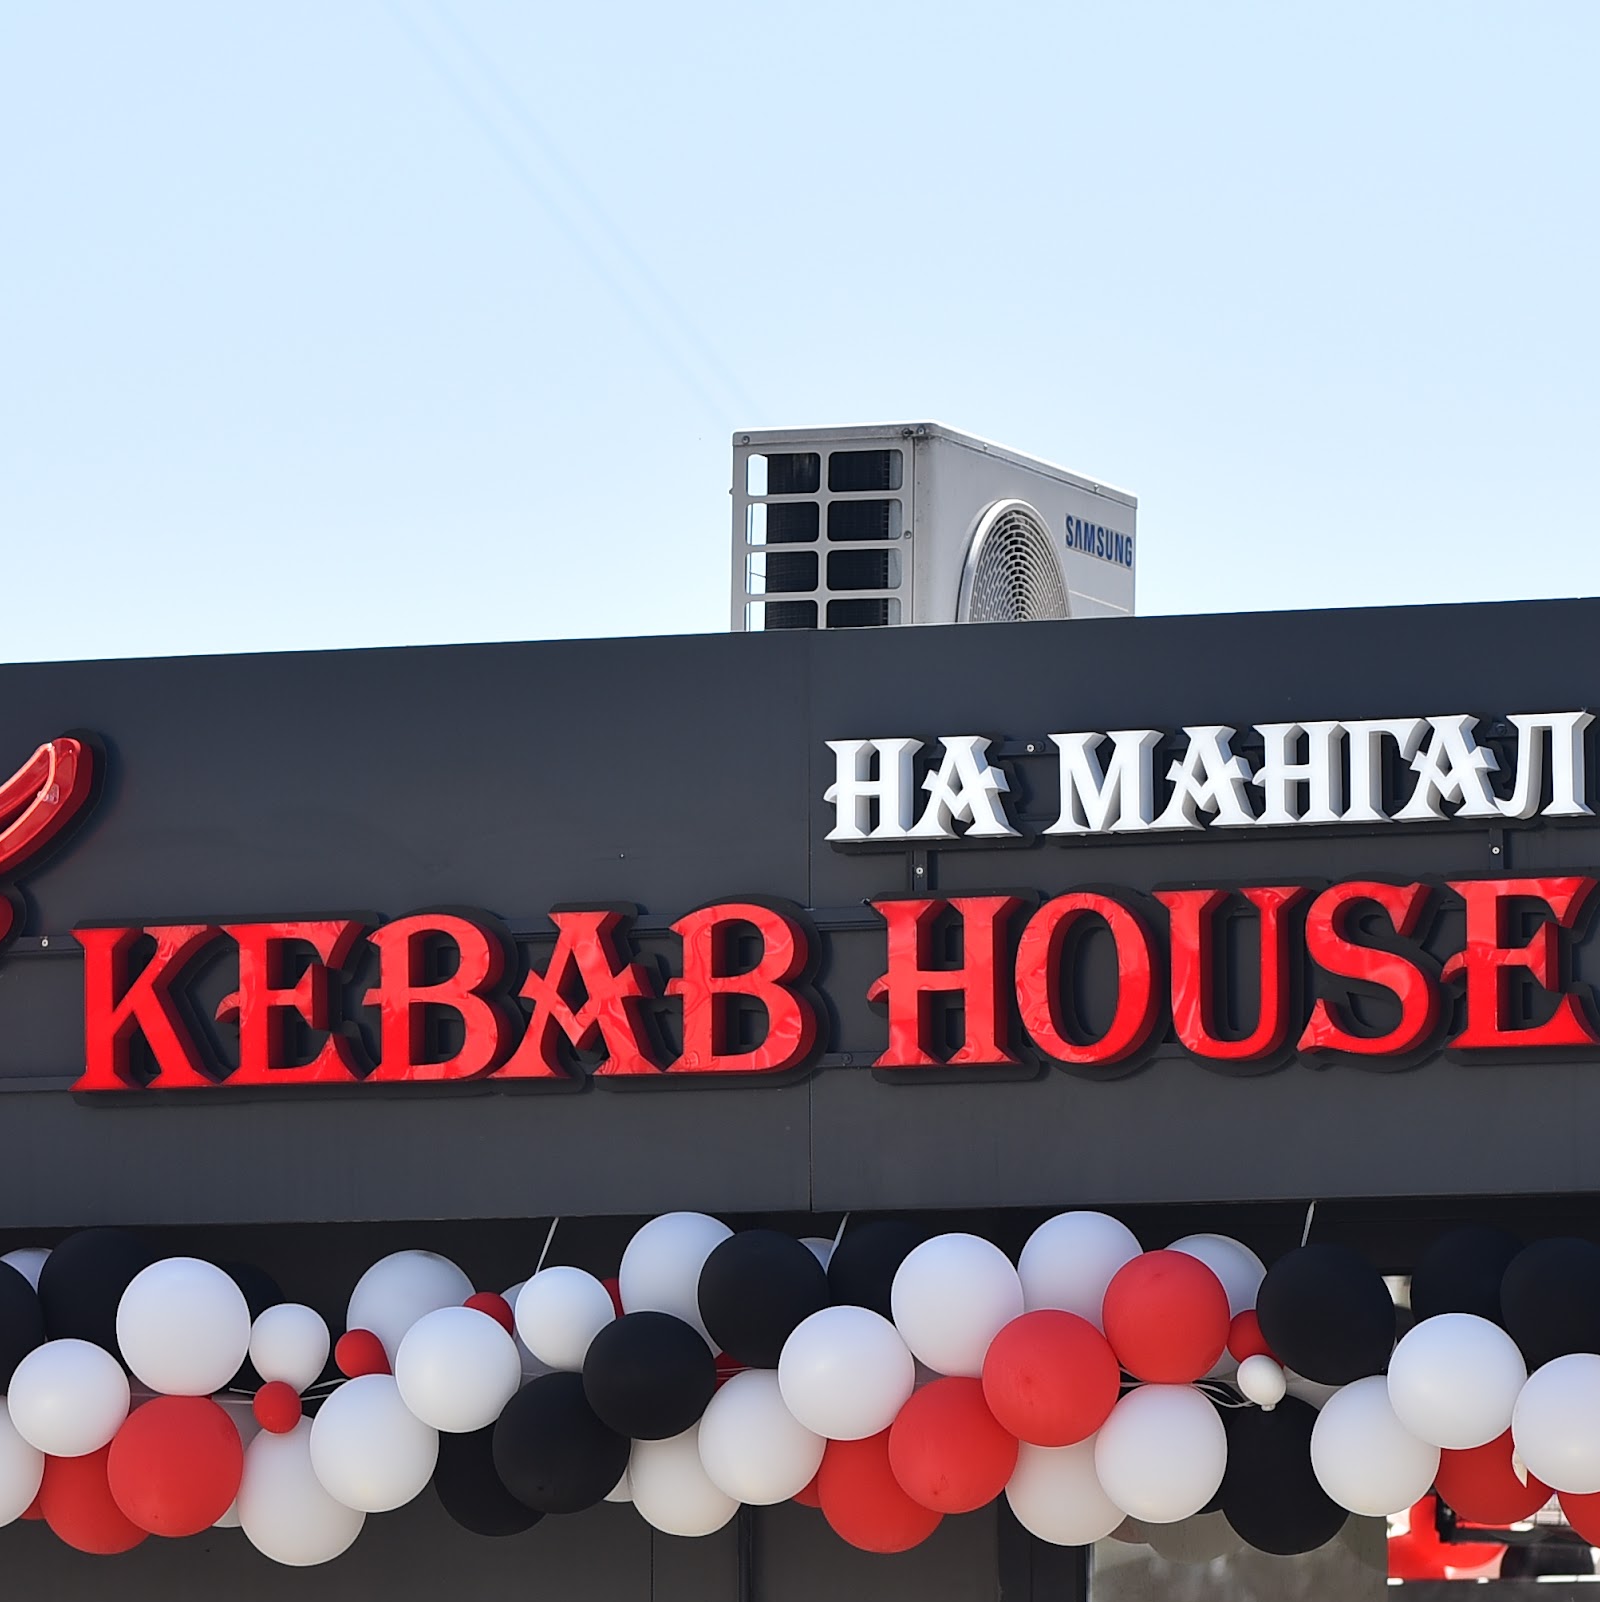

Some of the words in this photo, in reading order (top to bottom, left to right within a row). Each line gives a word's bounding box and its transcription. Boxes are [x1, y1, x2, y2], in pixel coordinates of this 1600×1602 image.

[1065, 514, 1133, 568] SAMSUNG
[823, 735, 1024, 842] НА
[1041, 709, 1599, 837] МАНГАЛ
[69, 902, 819, 1092] KEBAB
